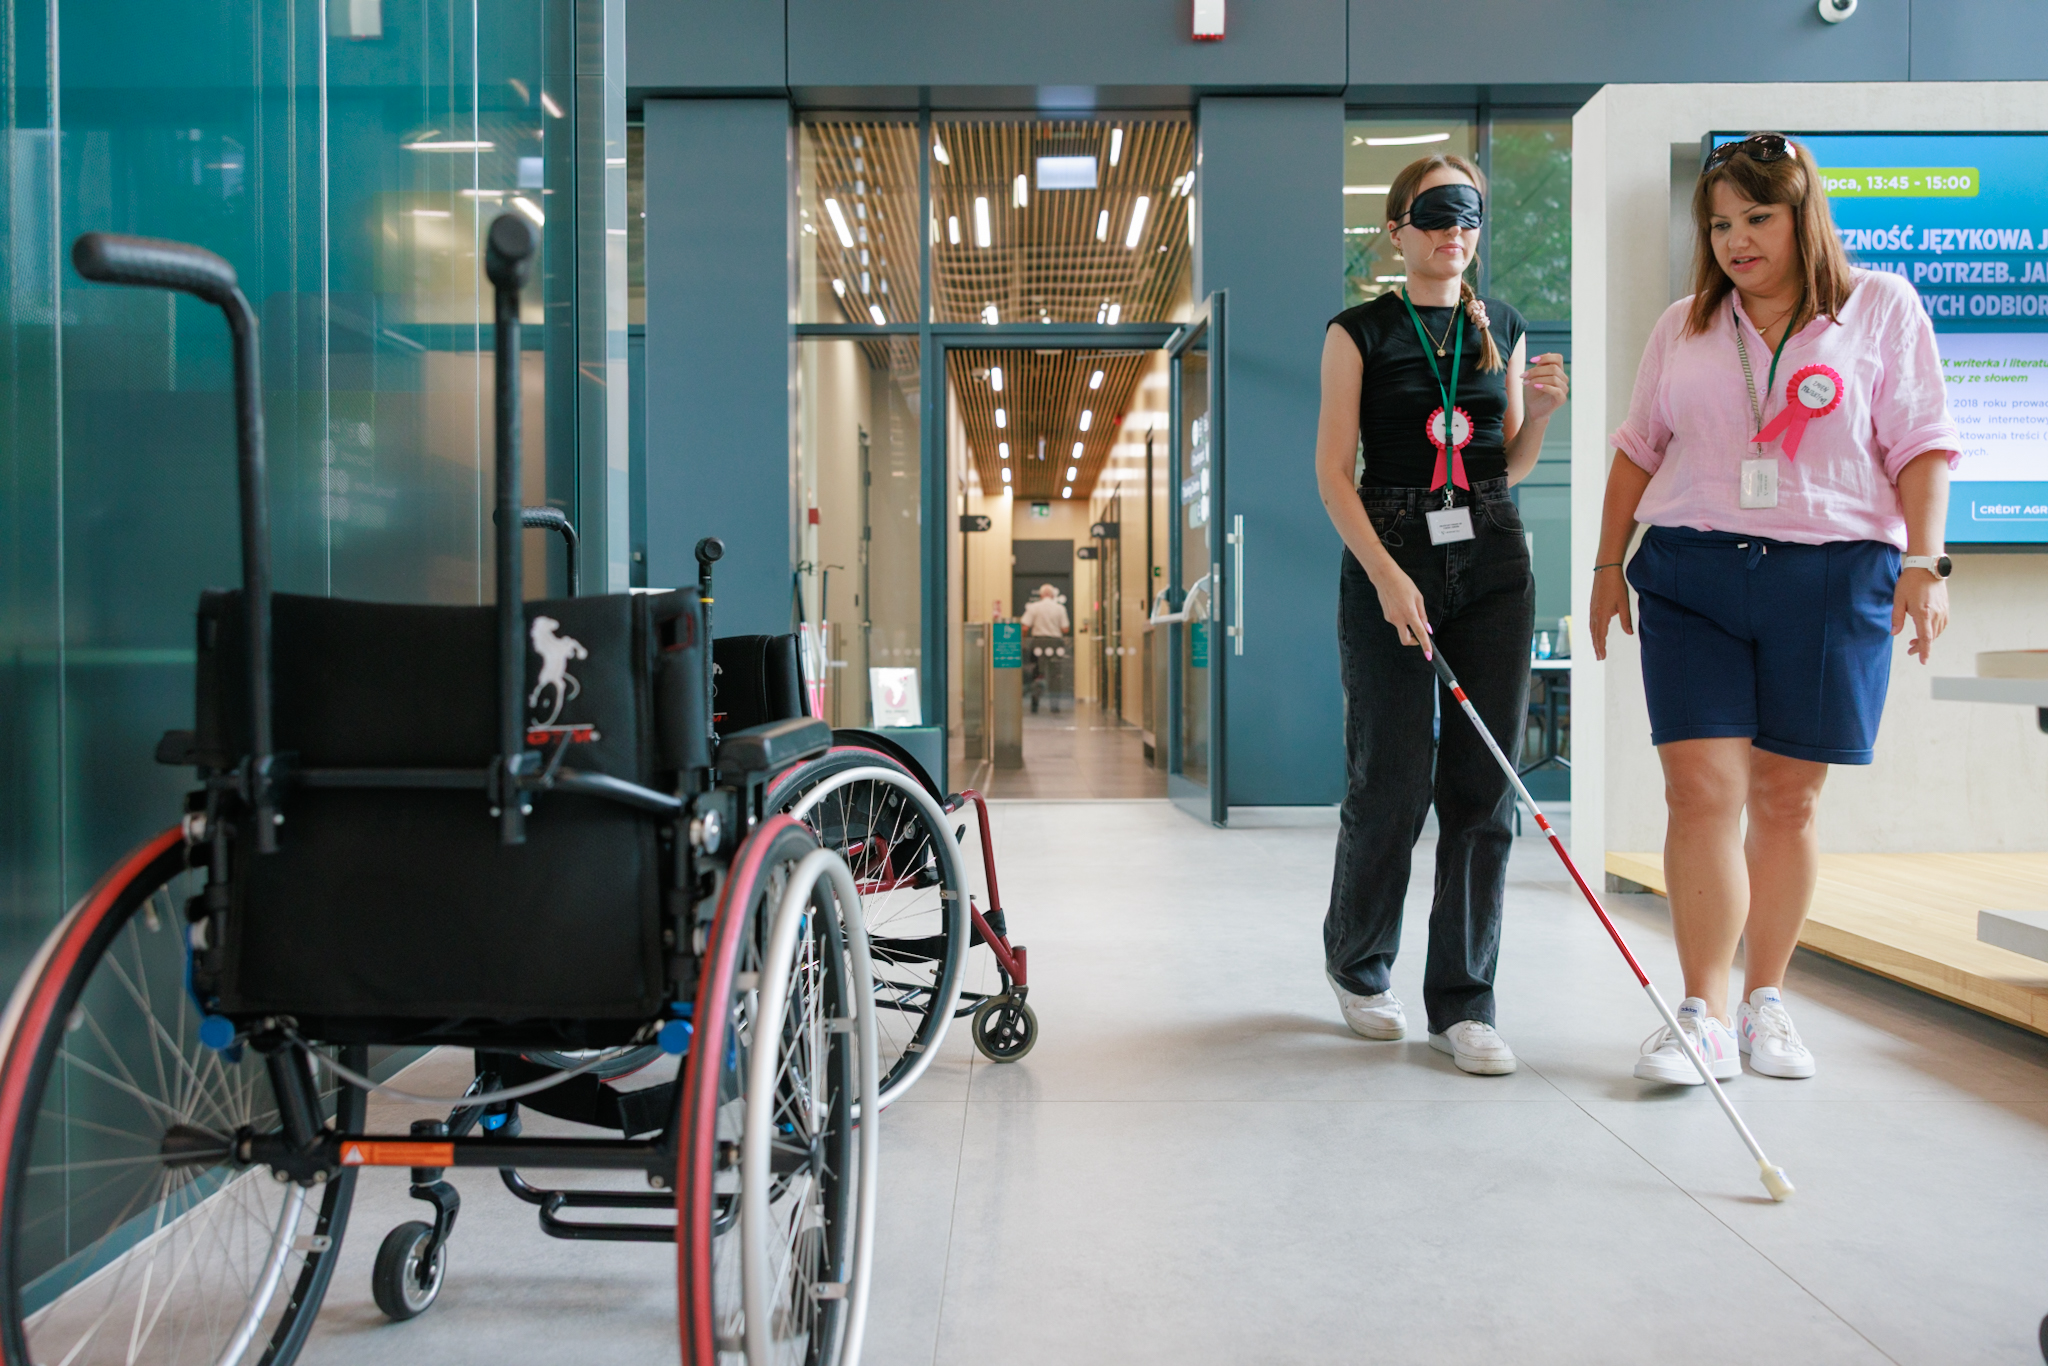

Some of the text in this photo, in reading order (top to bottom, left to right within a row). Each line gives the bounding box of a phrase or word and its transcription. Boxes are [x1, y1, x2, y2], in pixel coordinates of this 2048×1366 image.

[1866, 175, 1909, 190] 13:45
[1925, 175, 1971, 190] 15:00
[1918, 229, 2034, 255] JĘZYKOWA
[1914, 262, 2016, 283] POTRZEB.
[2020, 262, 2048, 283] JA
[1970, 294, 2048, 316] ODBIOR
[1953, 358, 2000, 368] writerka
[1968, 374, 1981, 383] ze
[1984, 373, 2028, 383] słowem
[1953, 399, 1978, 408] 2018
[1983, 399, 2007, 408] roku
[2011, 431, 2040, 440] treści
[1980, 504, 2048, 515] CRÉDIT AGR
